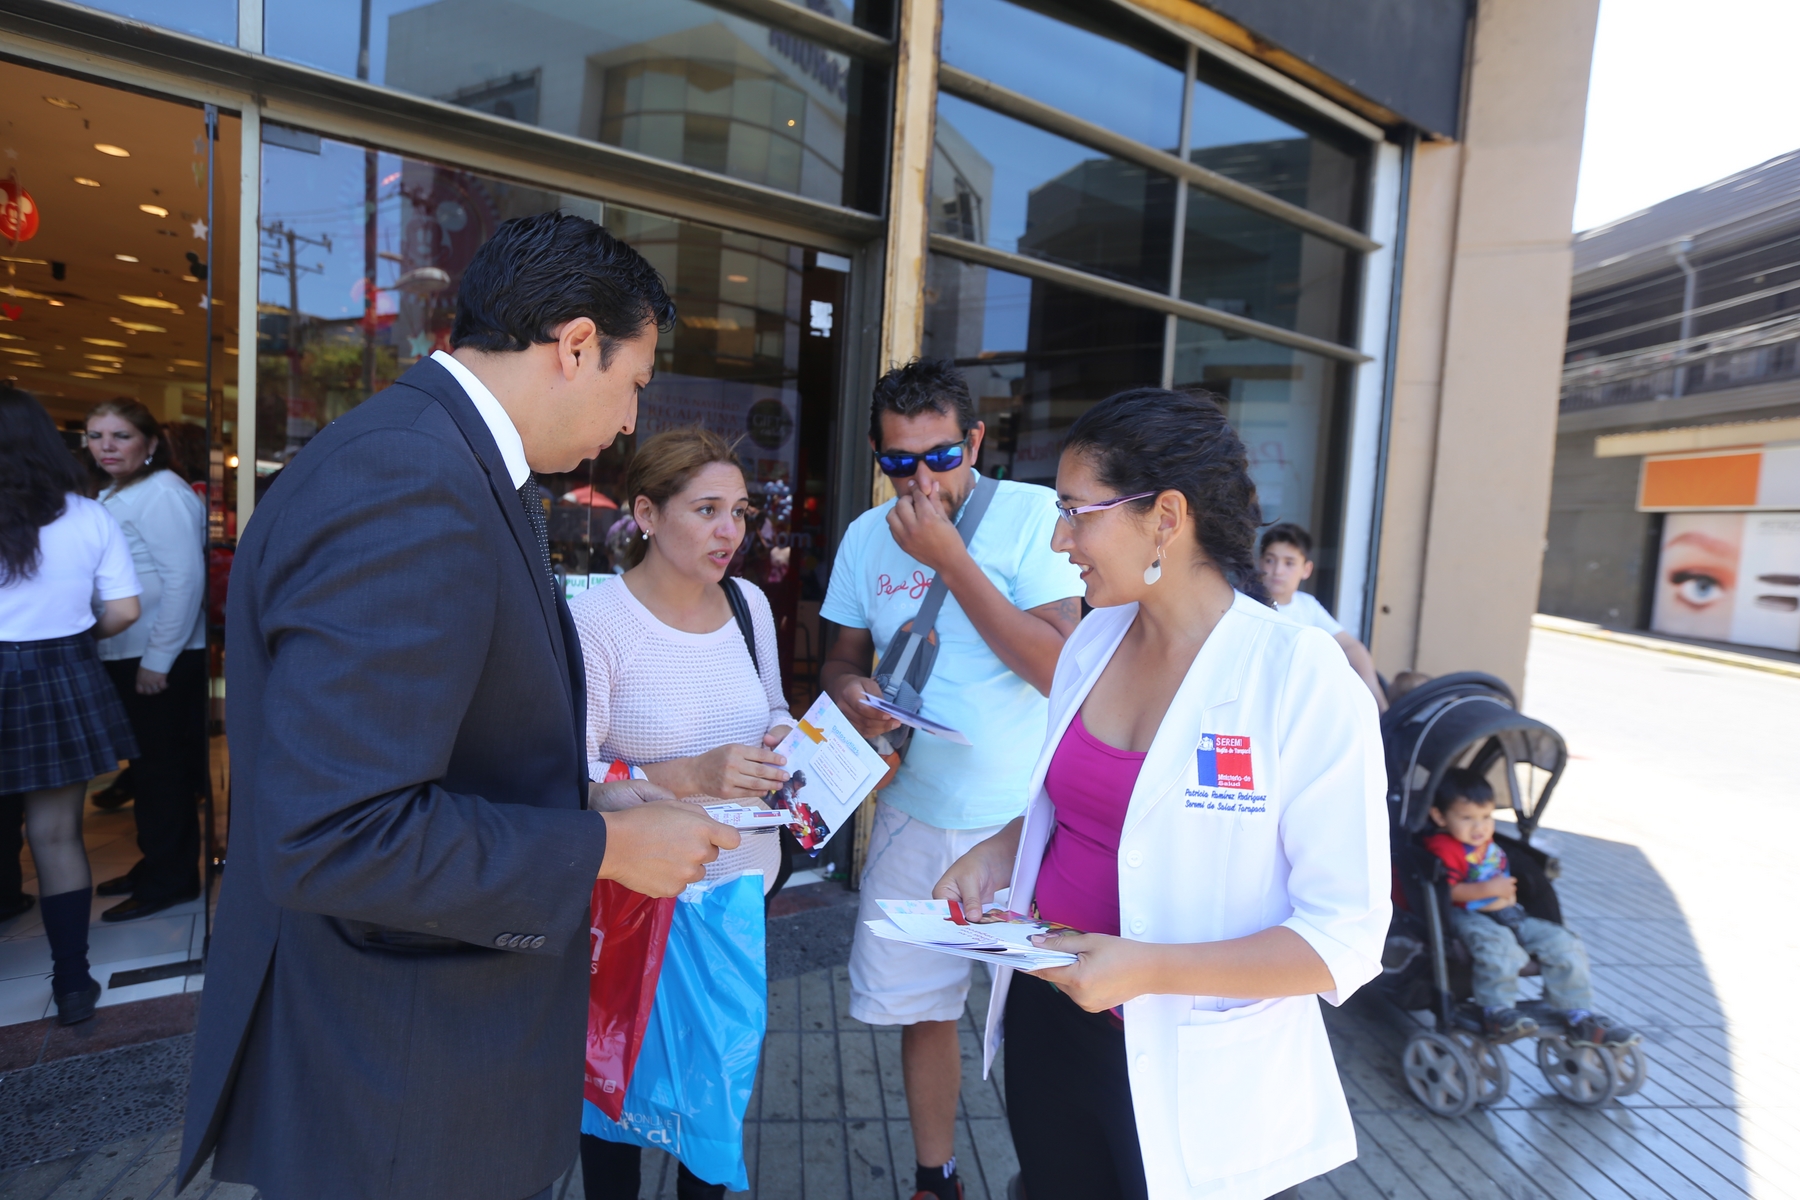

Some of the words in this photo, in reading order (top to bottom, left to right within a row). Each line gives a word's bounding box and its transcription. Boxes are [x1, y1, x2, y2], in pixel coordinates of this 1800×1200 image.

[693, 399, 740, 411] NAVIDAD
[648, 405, 702, 420] REGALA
[707, 411, 737, 424] UNA
[566, 579, 585, 587] PUJE
[877, 573, 909, 601] Pepe
[1216, 737, 1243, 746] SEREMI
[1218, 774, 1241, 782] Ministerio
[1185, 789, 1209, 798] Patricia
[1185, 800, 1204, 809] Seremi
[1217, 802, 1236, 812] Salud
